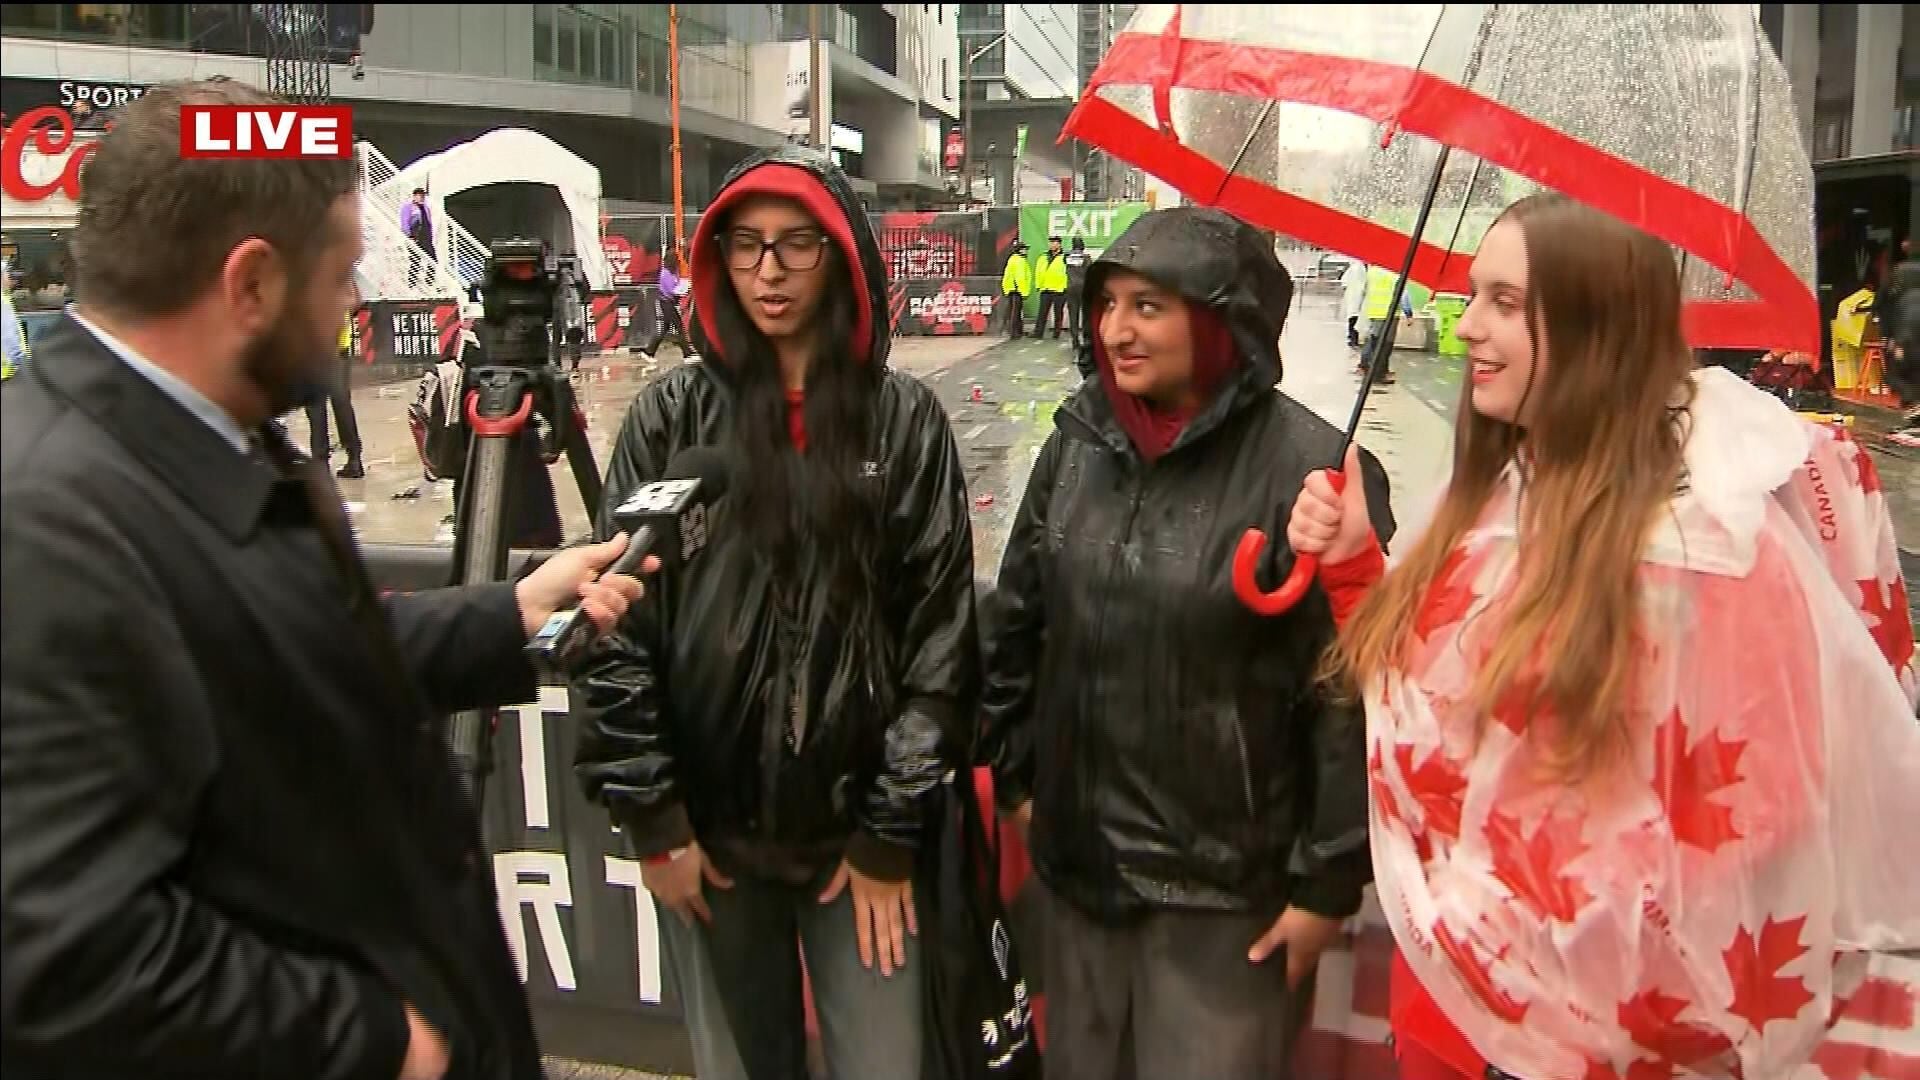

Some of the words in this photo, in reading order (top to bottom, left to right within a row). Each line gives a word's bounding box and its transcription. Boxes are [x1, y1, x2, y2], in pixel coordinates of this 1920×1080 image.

[60, 81, 149, 107] SPORT
[1049, 209, 1118, 237] EXIT
[410, 312, 439, 333] THE
[394, 335, 440, 355] NORTH
